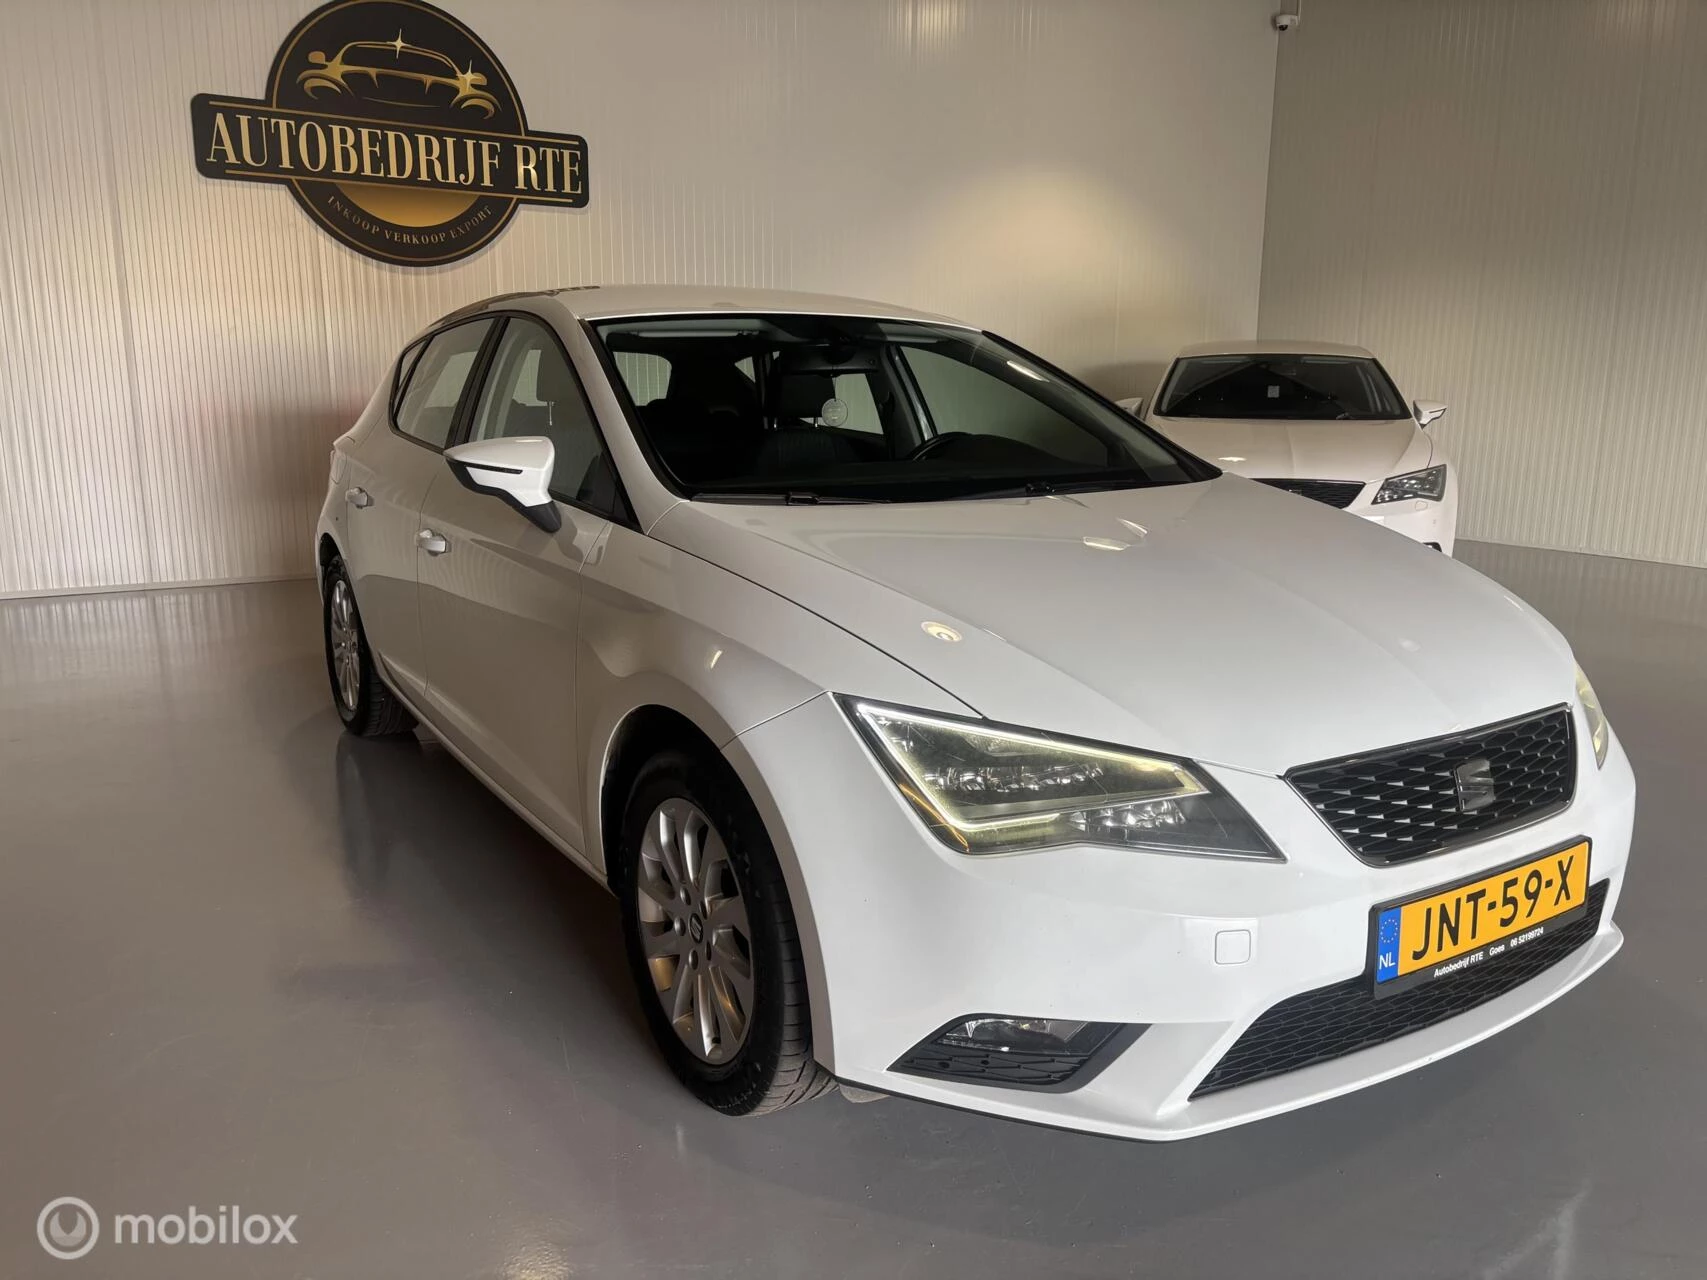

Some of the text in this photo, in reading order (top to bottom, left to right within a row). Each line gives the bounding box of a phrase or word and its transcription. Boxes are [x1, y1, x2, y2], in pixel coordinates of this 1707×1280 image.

[205, 112, 583, 194] AUTOBEDRIJF RTE
[327, 195, 493, 245] INKOOP VERKOOP EXPORT
[1412, 855, 1574, 961] JNT-59-X
[1378, 953, 1396, 971] NL
[1433, 956, 1470, 978] Autobedrijf
[1470, 951, 1484, 964] RTE
[1489, 944, 1505, 957] Goes
